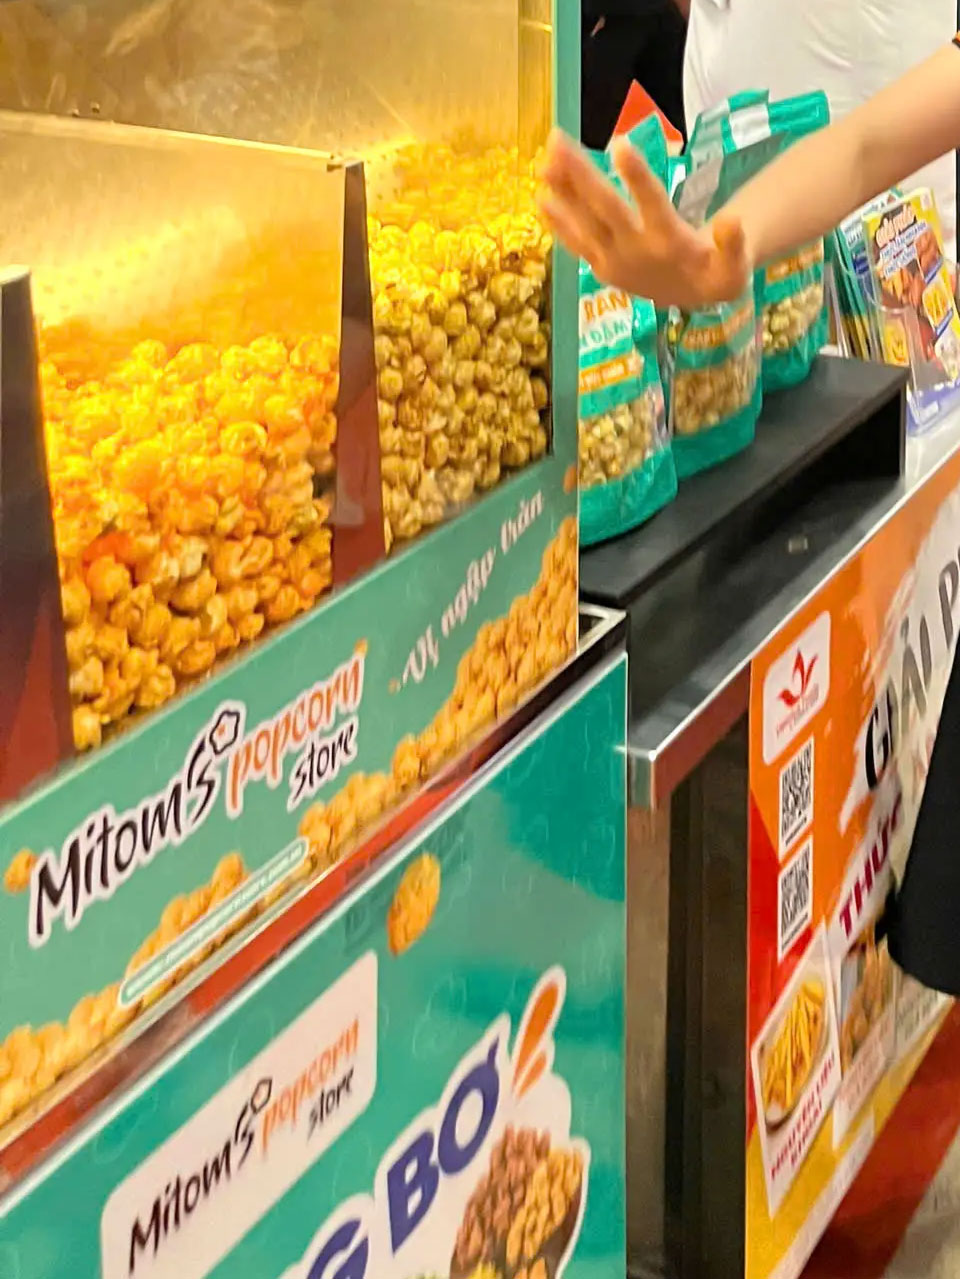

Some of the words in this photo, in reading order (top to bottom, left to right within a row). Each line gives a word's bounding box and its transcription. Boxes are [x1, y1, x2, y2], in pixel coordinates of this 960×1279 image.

[228, 657, 362, 811] popcorn
[290, 722, 357, 801] store
[262, 1014, 360, 1158] popcorn
[306, 1066, 355, 1141] store
[386, 1032, 501, 1258] BƠ
